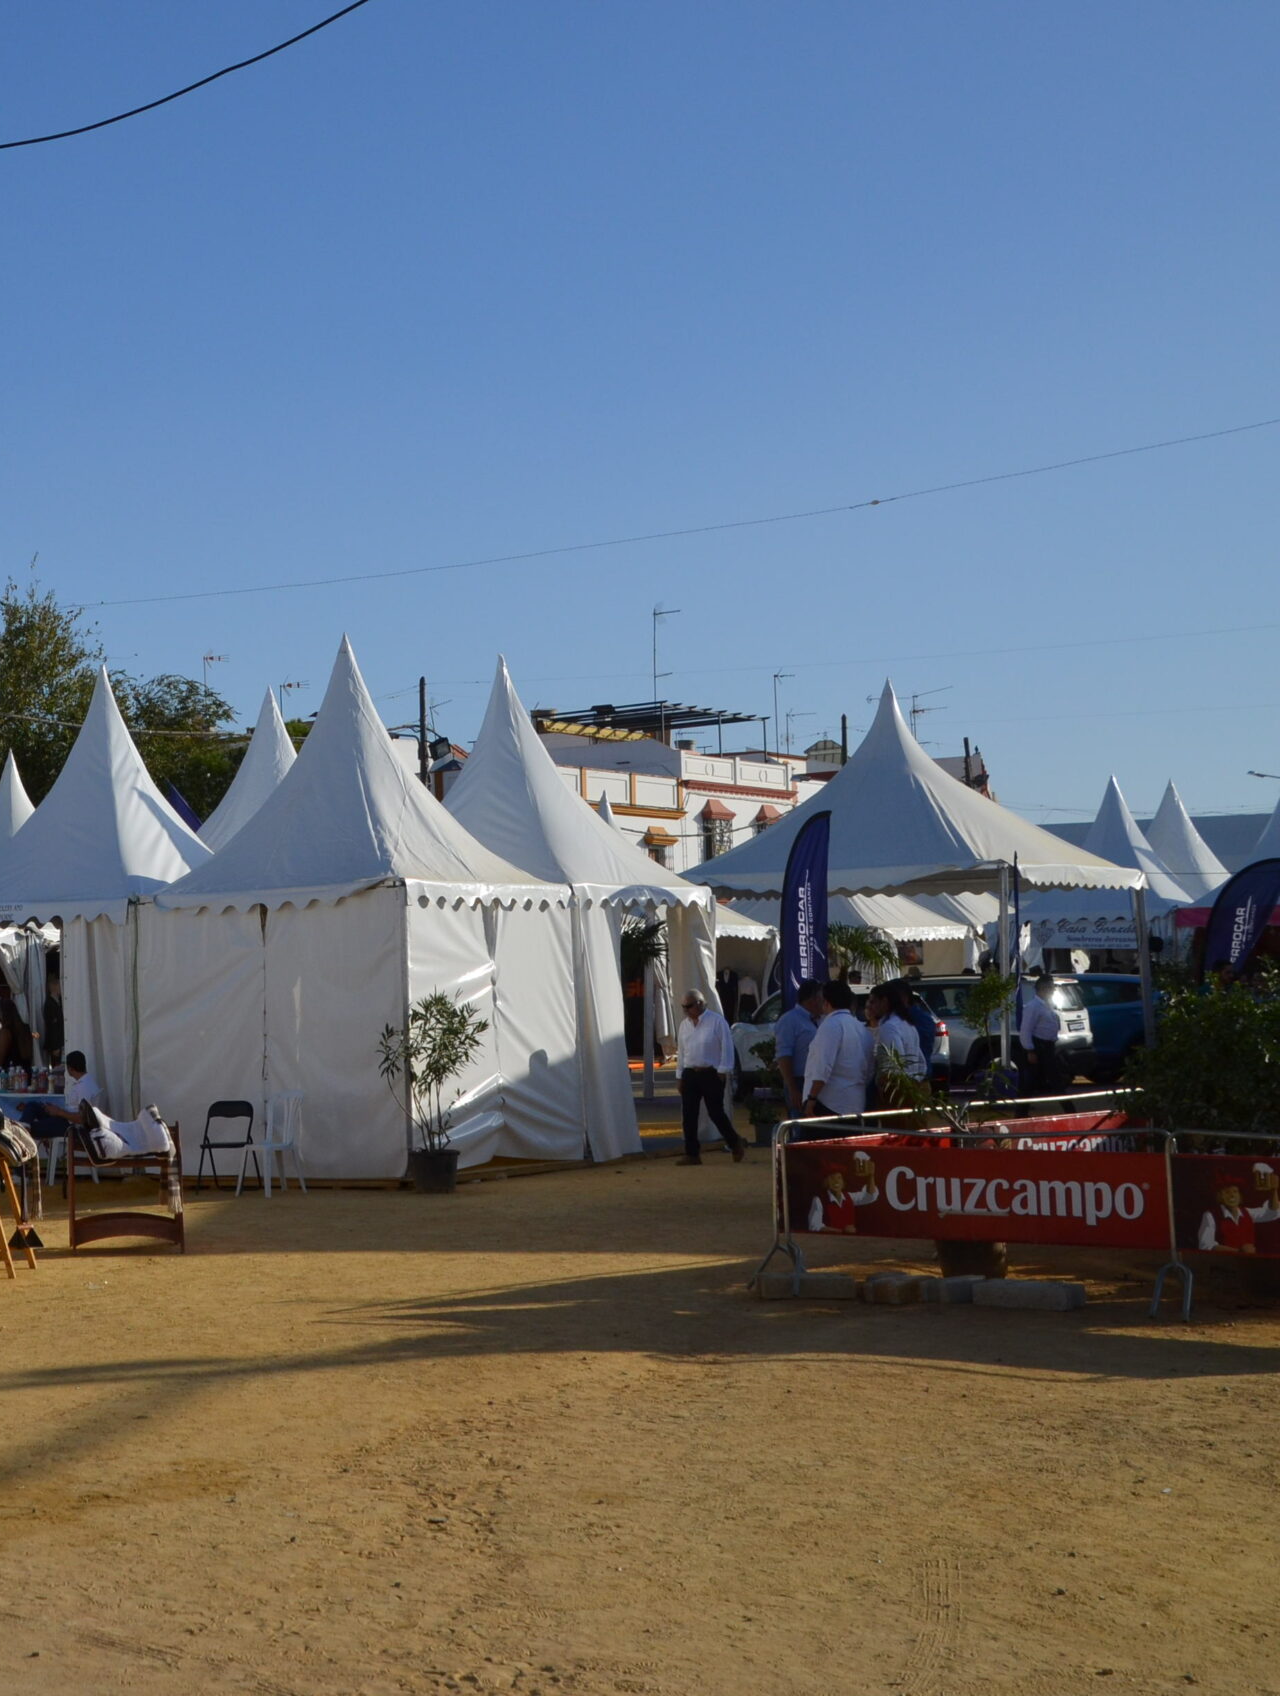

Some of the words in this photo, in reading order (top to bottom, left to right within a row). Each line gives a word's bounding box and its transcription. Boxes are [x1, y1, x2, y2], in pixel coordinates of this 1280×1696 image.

[798, 887, 808, 979] BERROCAR
[1230, 907, 1246, 964] ERROCAR
[885, 1166, 1145, 1226] Cruzcampo
